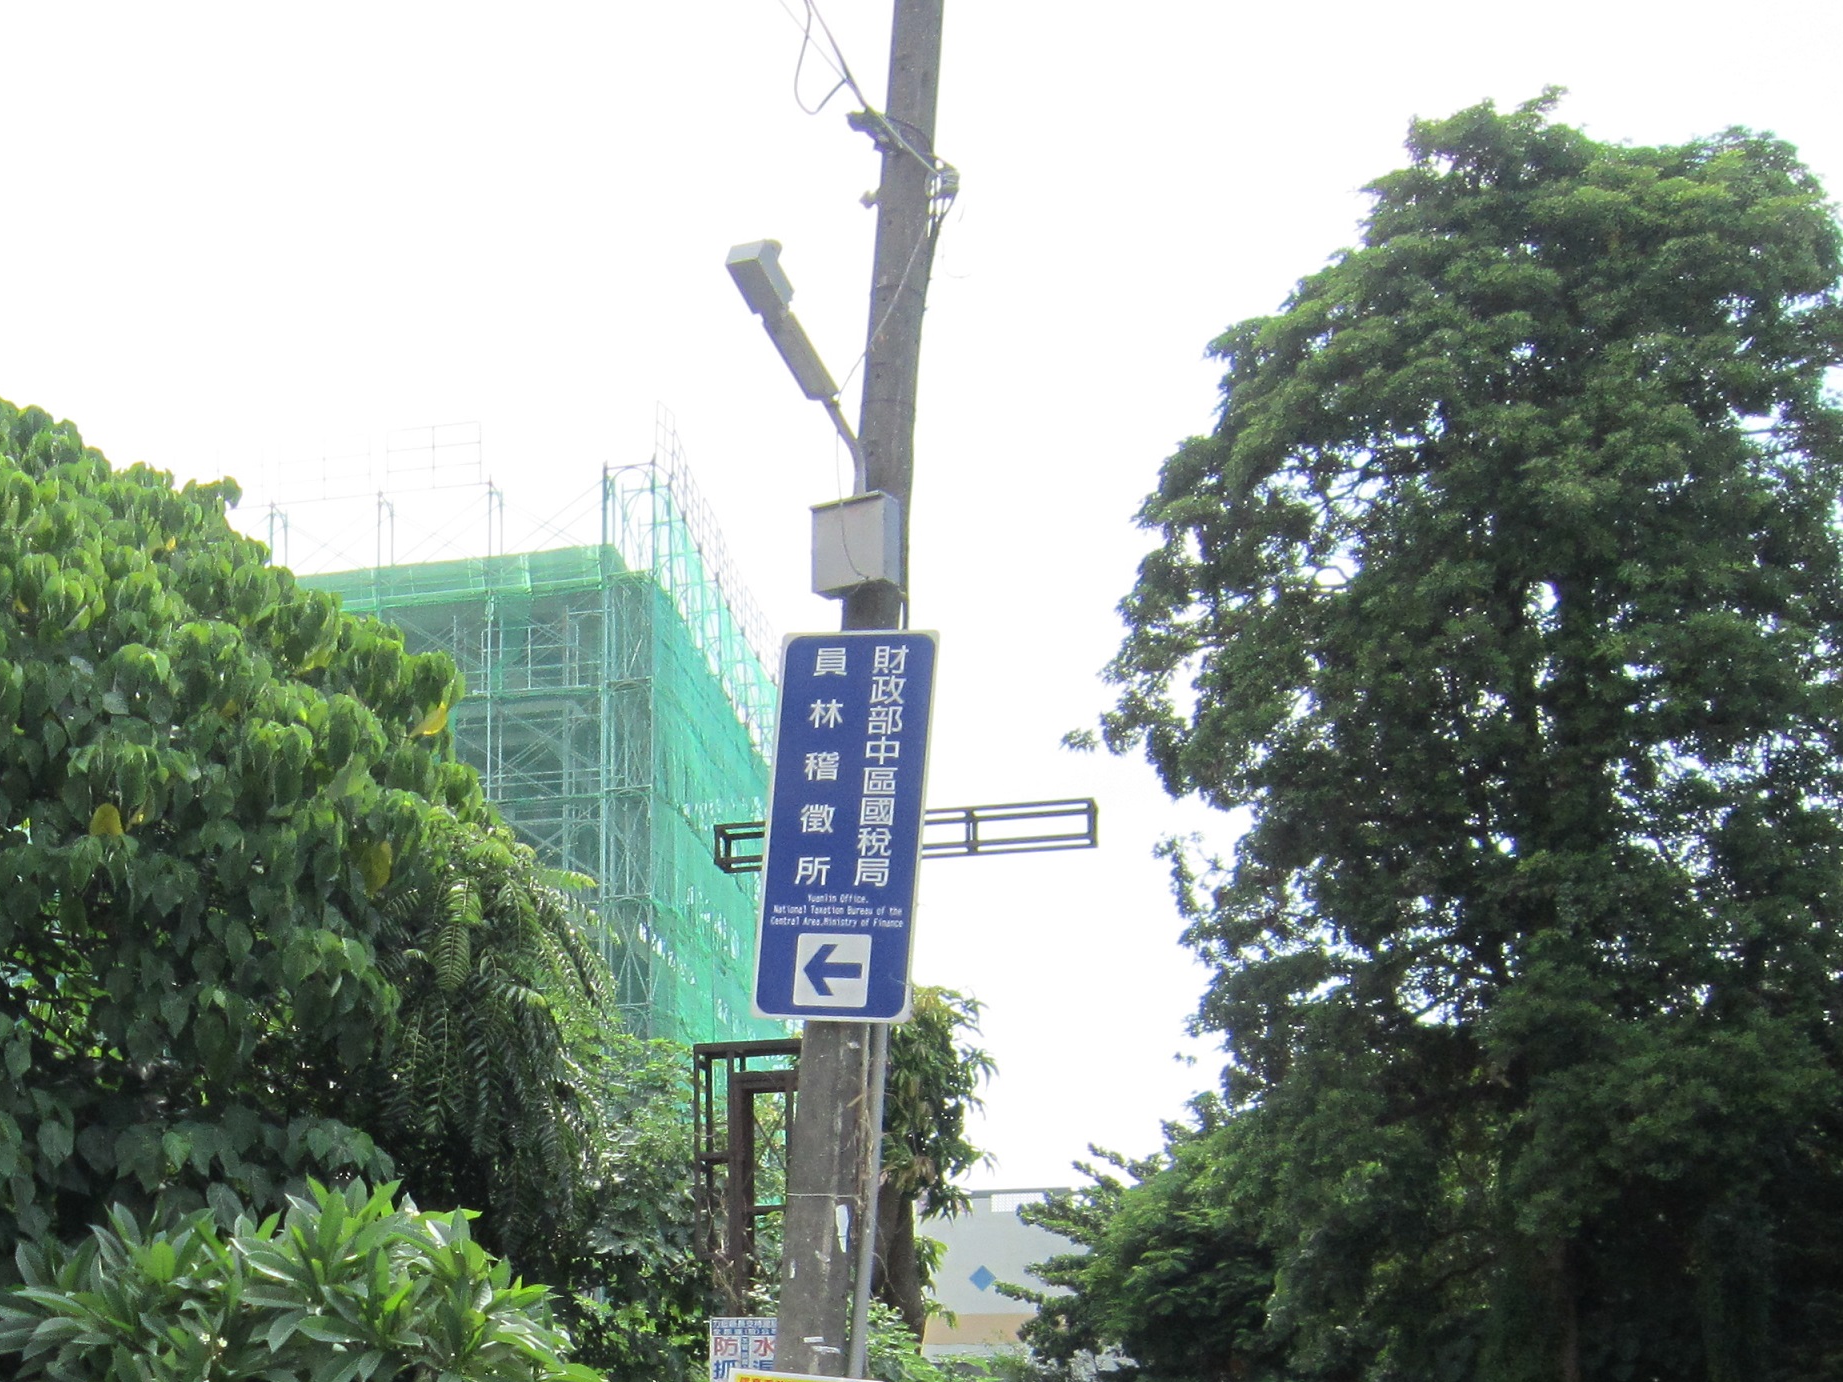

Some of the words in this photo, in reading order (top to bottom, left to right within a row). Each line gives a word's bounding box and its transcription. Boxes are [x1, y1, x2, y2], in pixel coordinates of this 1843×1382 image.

[794, 648, 847, 885] 員林稽徵所
[854, 645, 909, 886] 財政部中區國稅局
[808, 894, 837, 903] Yuanlin
[773, 905, 807, 914] National
[811, 905, 844, 915] Taxation
[847, 905, 873, 915] Bureau
[876, 906, 886, 915] of
[889, 907, 903, 916] the
[770, 916, 800, 926] Central
[861, 918, 870, 927] of
[873, 918, 904, 928] Finance
